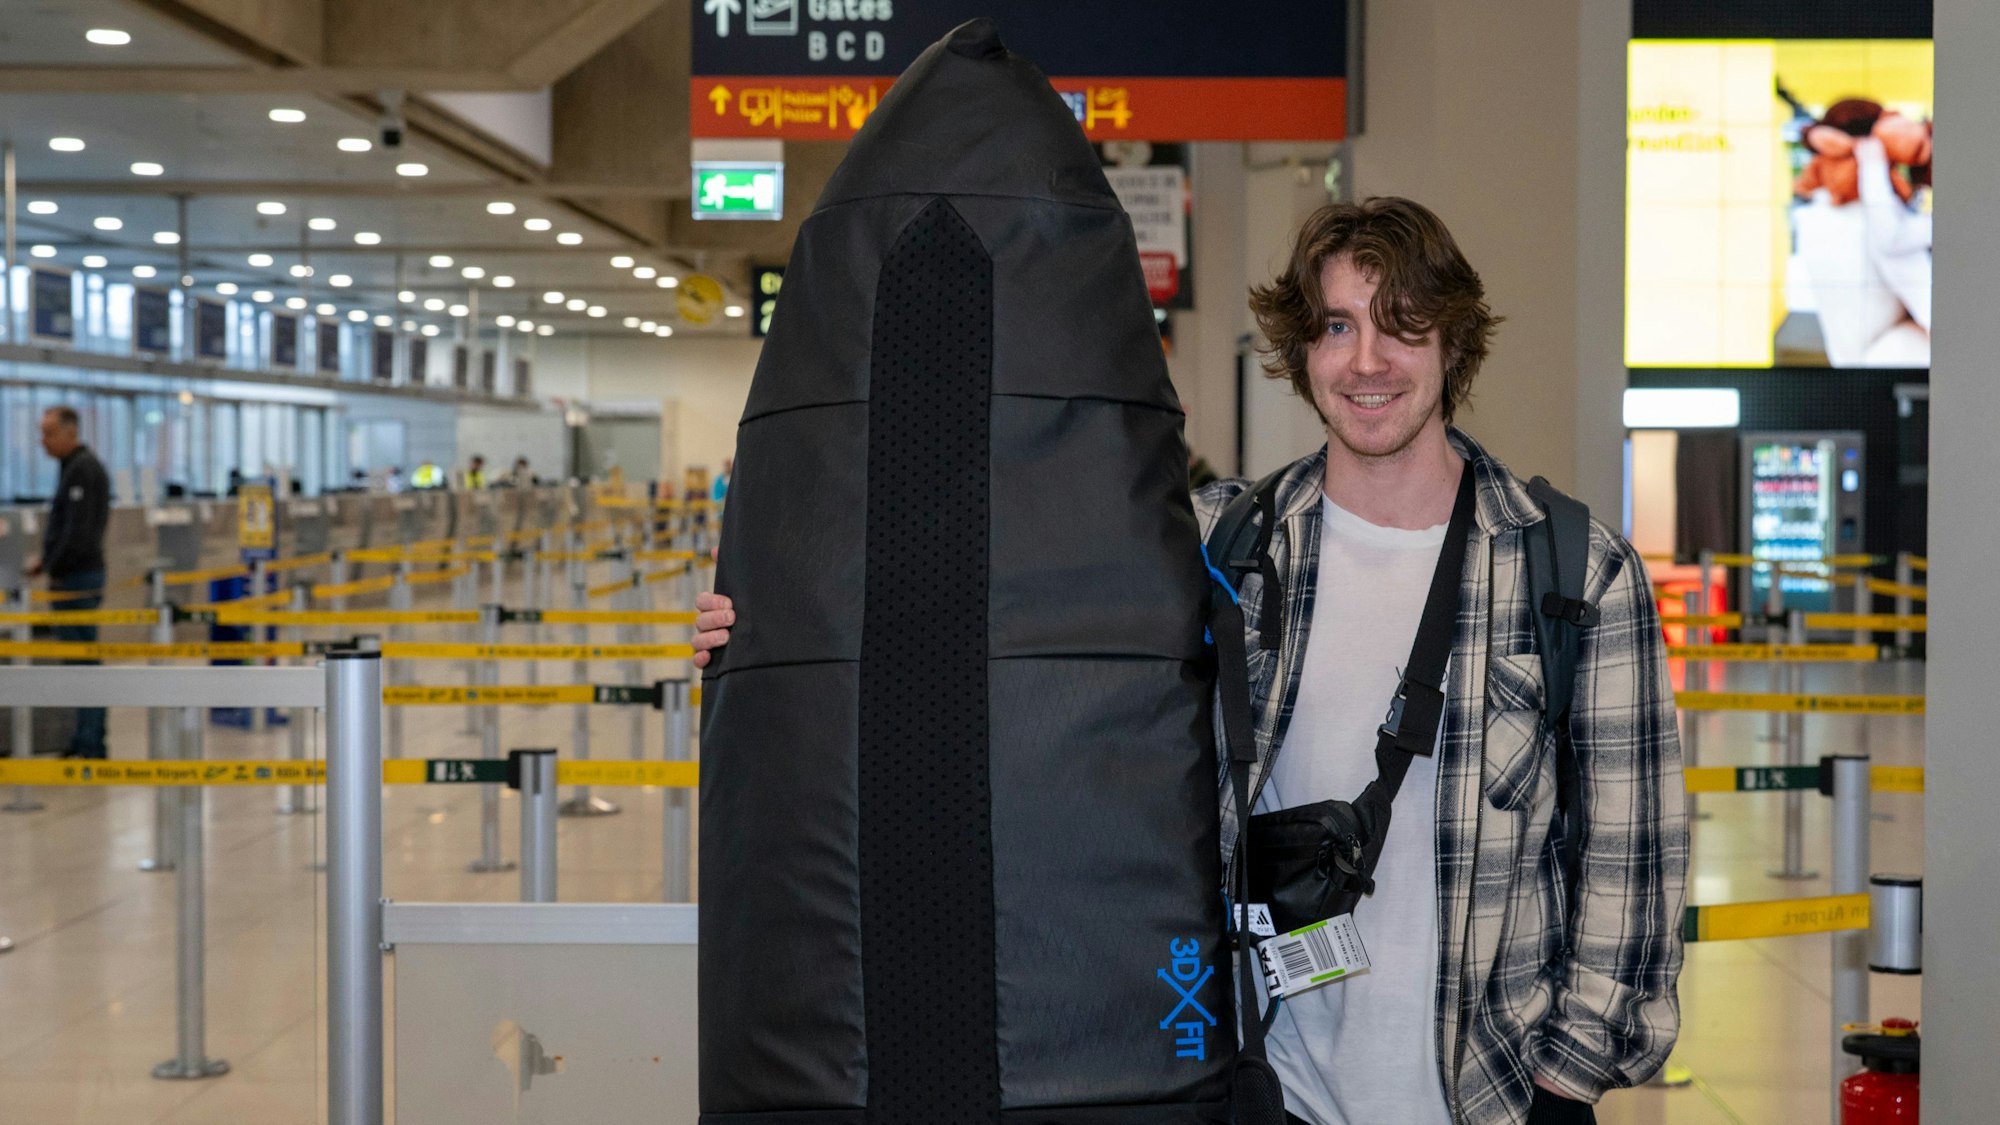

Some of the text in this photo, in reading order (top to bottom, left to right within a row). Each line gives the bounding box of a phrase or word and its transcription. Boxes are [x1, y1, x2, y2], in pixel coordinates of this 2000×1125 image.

[808, 31, 885, 61] B C D
